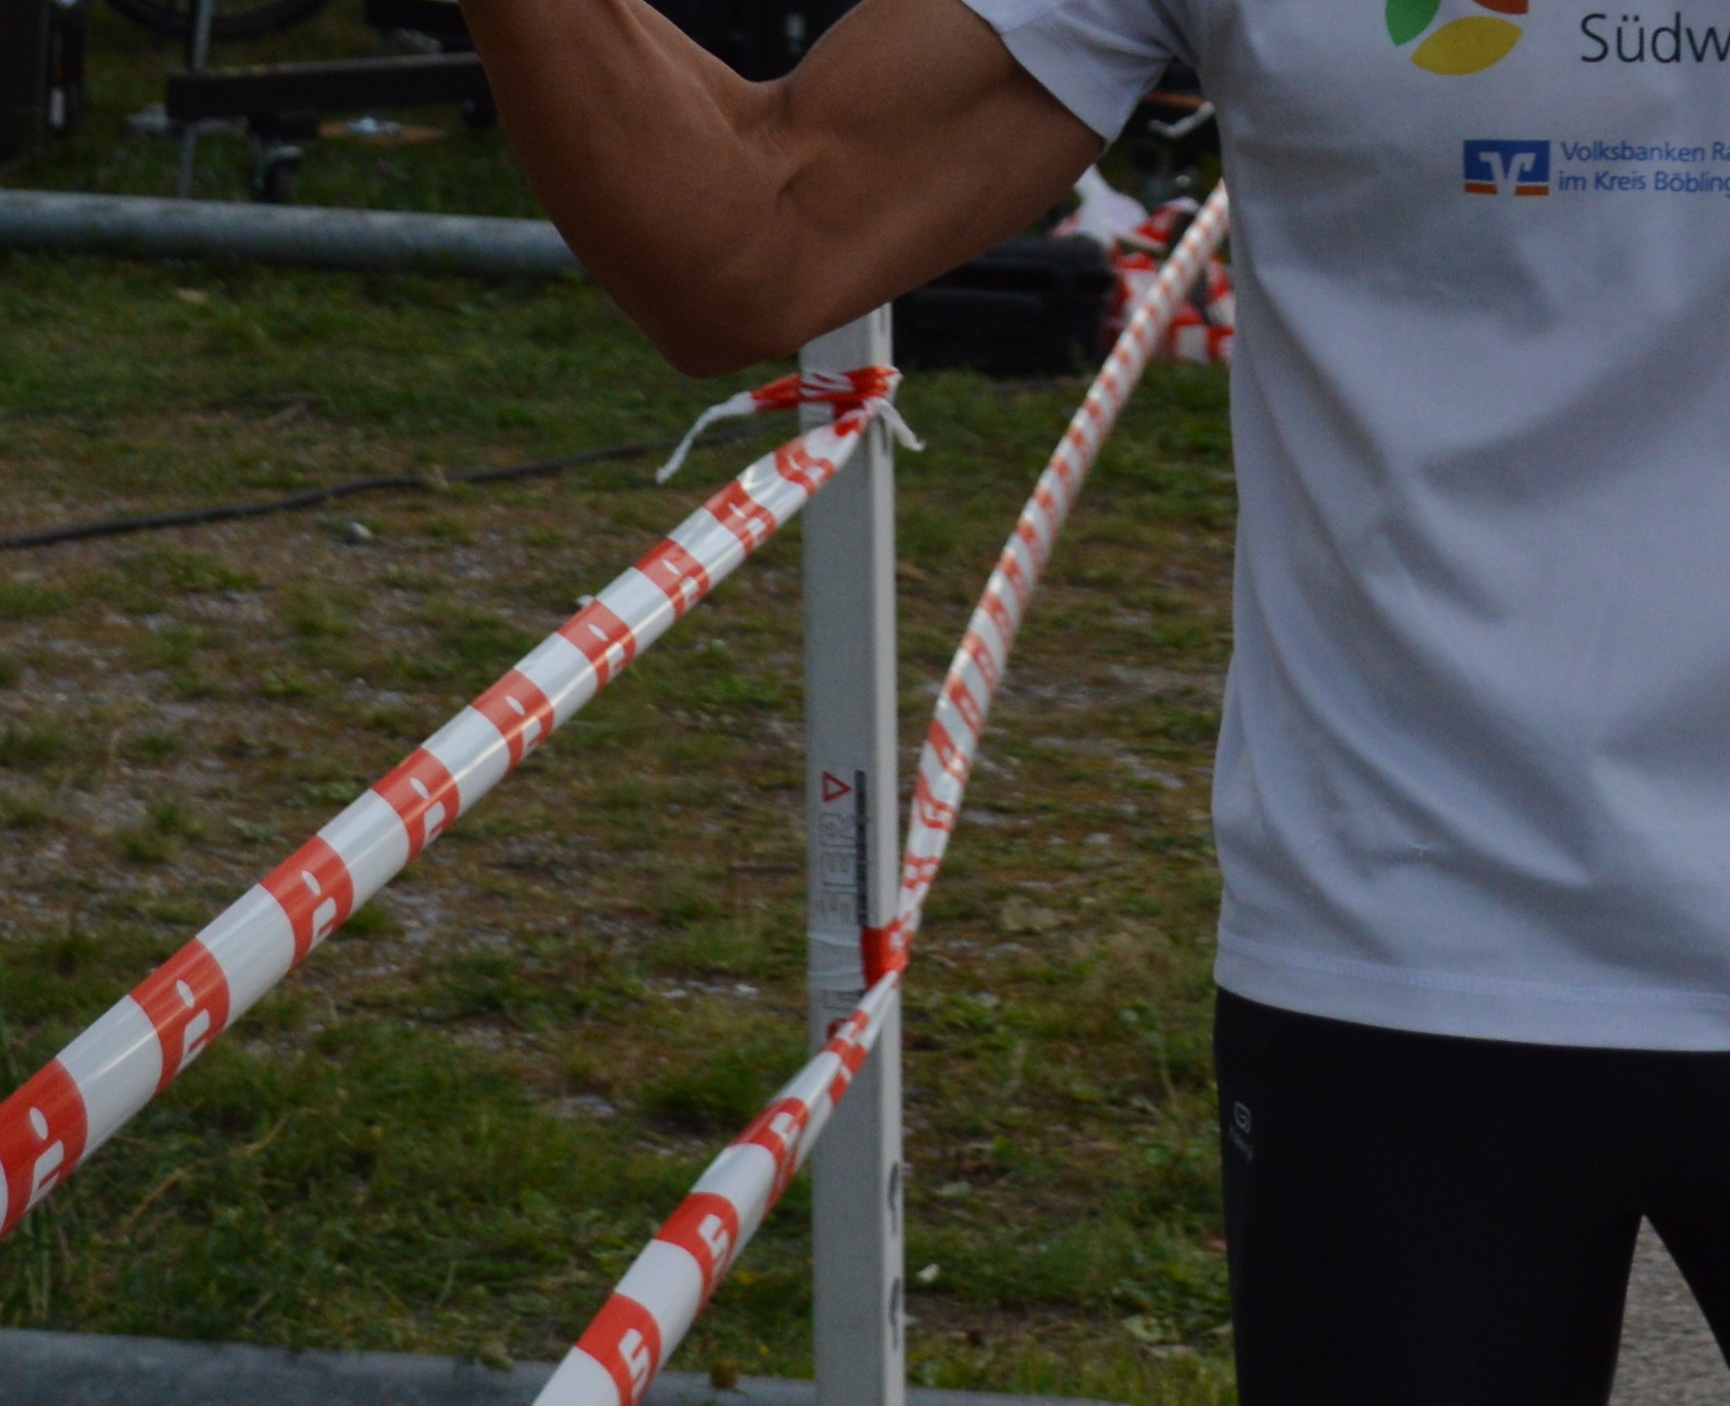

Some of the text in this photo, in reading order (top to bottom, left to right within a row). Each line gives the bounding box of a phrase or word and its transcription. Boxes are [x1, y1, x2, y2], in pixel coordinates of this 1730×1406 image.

[1561, 140, 1705, 164] Volksbanken
[1558, 171, 1587, 192] im
[1593, 170, 1647, 193] Kreis
